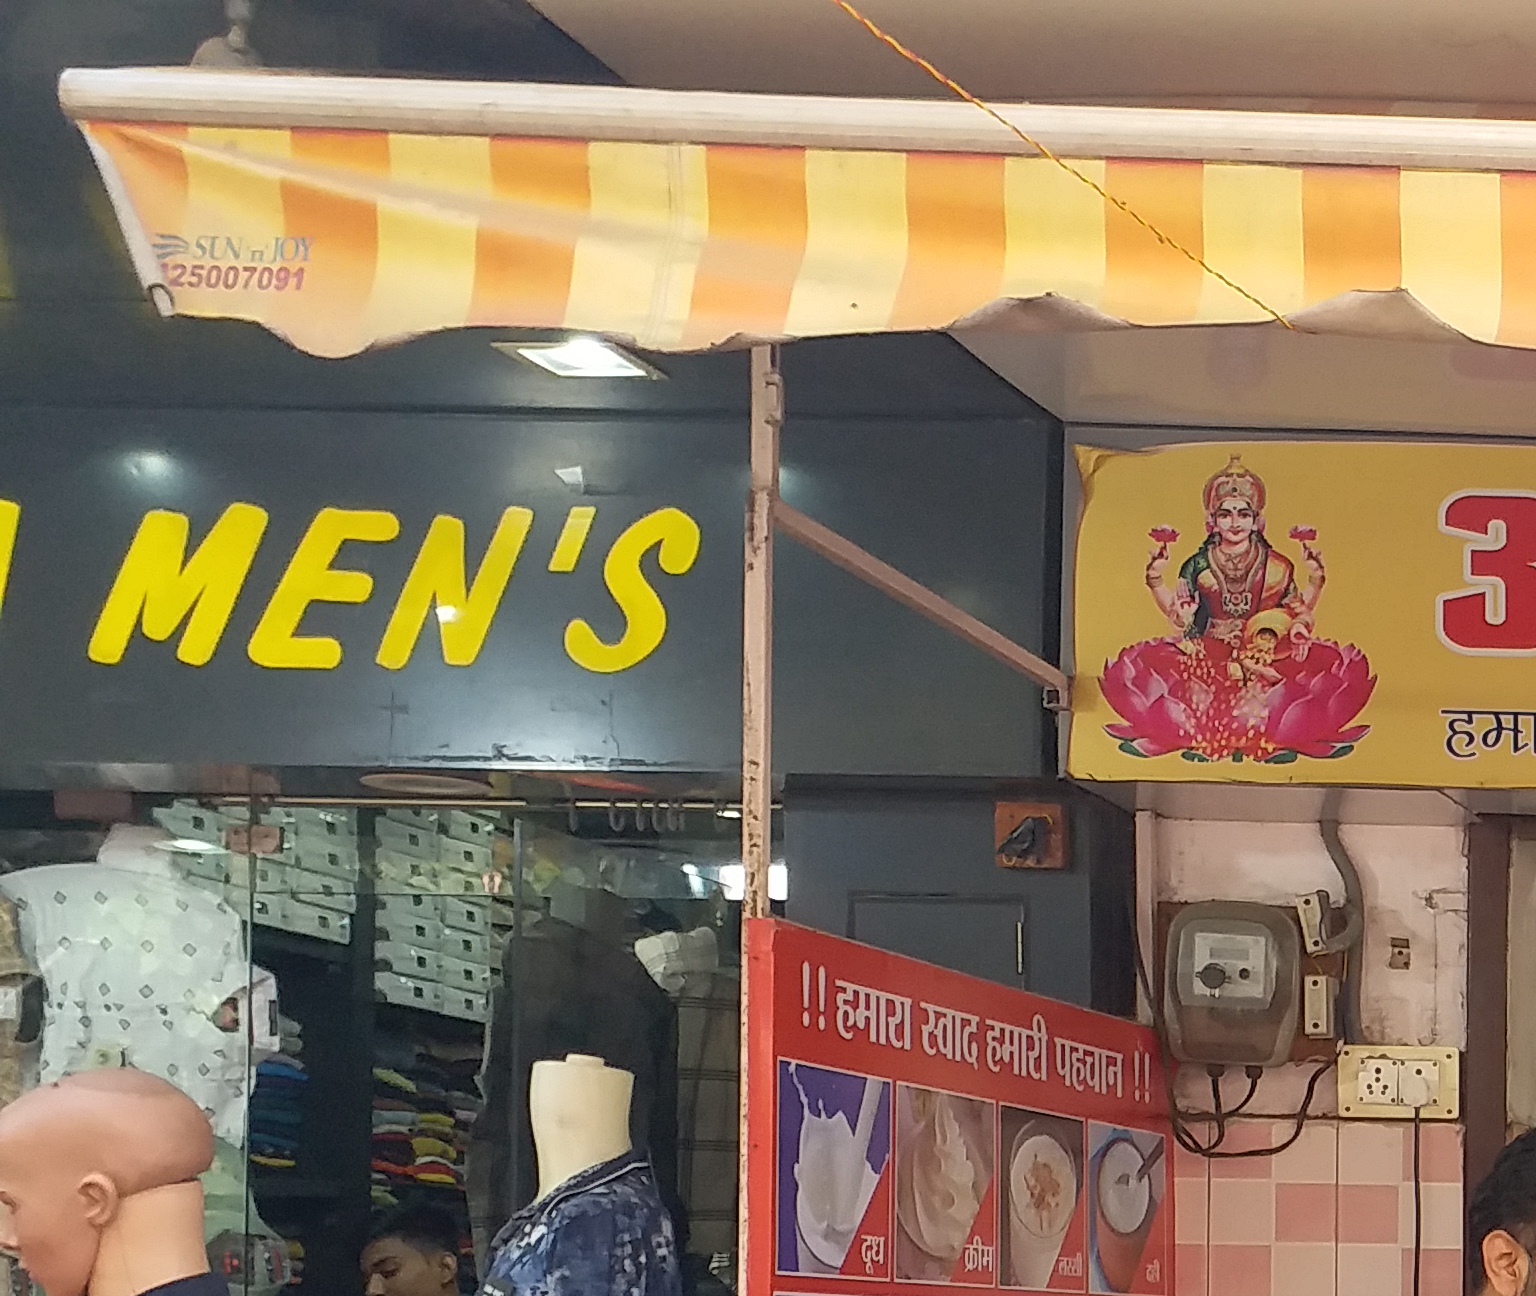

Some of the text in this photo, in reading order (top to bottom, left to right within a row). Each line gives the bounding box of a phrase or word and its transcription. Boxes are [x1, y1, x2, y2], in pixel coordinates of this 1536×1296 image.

[194, 236, 244, 261] SUN
[272, 235, 315, 264] JOY
[161, 262, 305, 291] 25007091
[87, 501, 702, 674] MEN'S
[834, 978, 912, 1052] हमारा
[918, 1001, 980, 1071] स्वाद
[984, 1013, 1049, 1083] हमारी
[1053, 1036, 1125, 1100] पहचान
[860, 1234, 886, 1275] दूध
[963, 1235, 994, 1273] क्रीम
